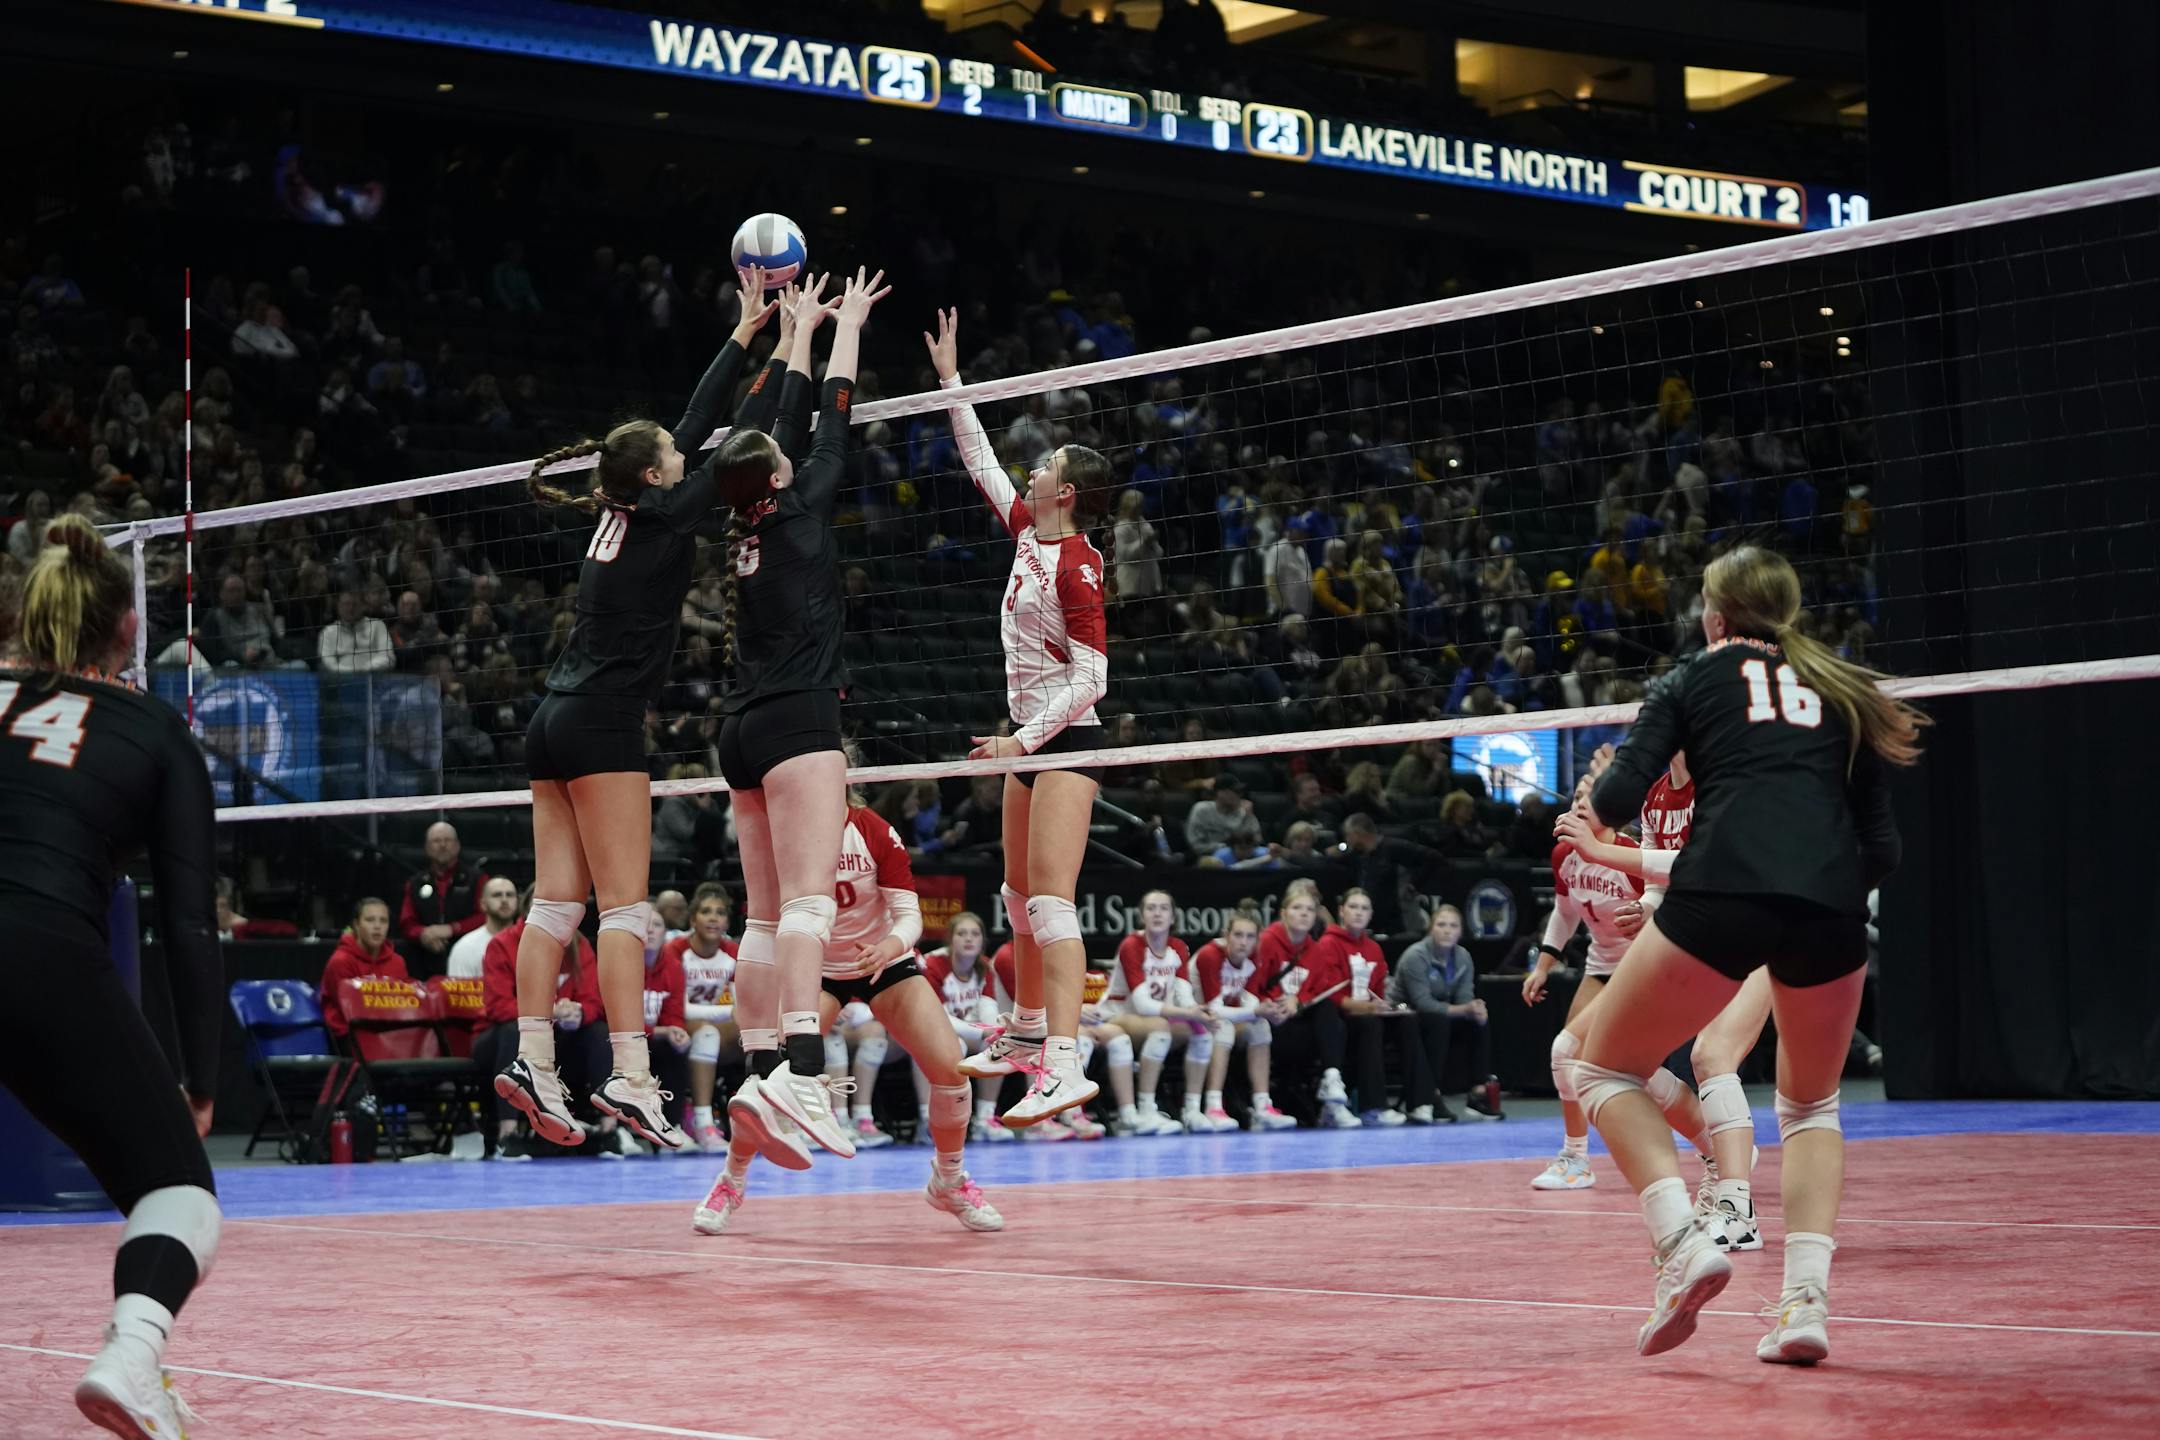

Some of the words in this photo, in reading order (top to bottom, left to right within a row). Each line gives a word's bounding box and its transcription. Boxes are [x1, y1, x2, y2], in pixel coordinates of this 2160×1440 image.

[649, 19, 860, 91] WAYZATA
[950, 58, 995, 88] SETS
[877, 52, 925, 101] 25
[963, 84, 982, 116] 2
[1025, 94, 1036, 121] 1
[1061, 88, 1130, 125] MATCH
[1200, 96, 1241, 125] SETS
[1161, 113, 1177, 141] 0
[1256, 109, 1299, 155] 23
[1319, 119, 1495, 180] LAKEVILLE
[1500, 147, 1608, 197] NORTH
[1638, 171, 1767, 220] COURT
[1776, 187, 1800, 224] 2
[586, 508, 630, 563] 10
[1741, 659, 1822, 729] 16
[1579, 874, 1624, 899] KNIGHTS
[364, 994, 420, 1009] FARGO
